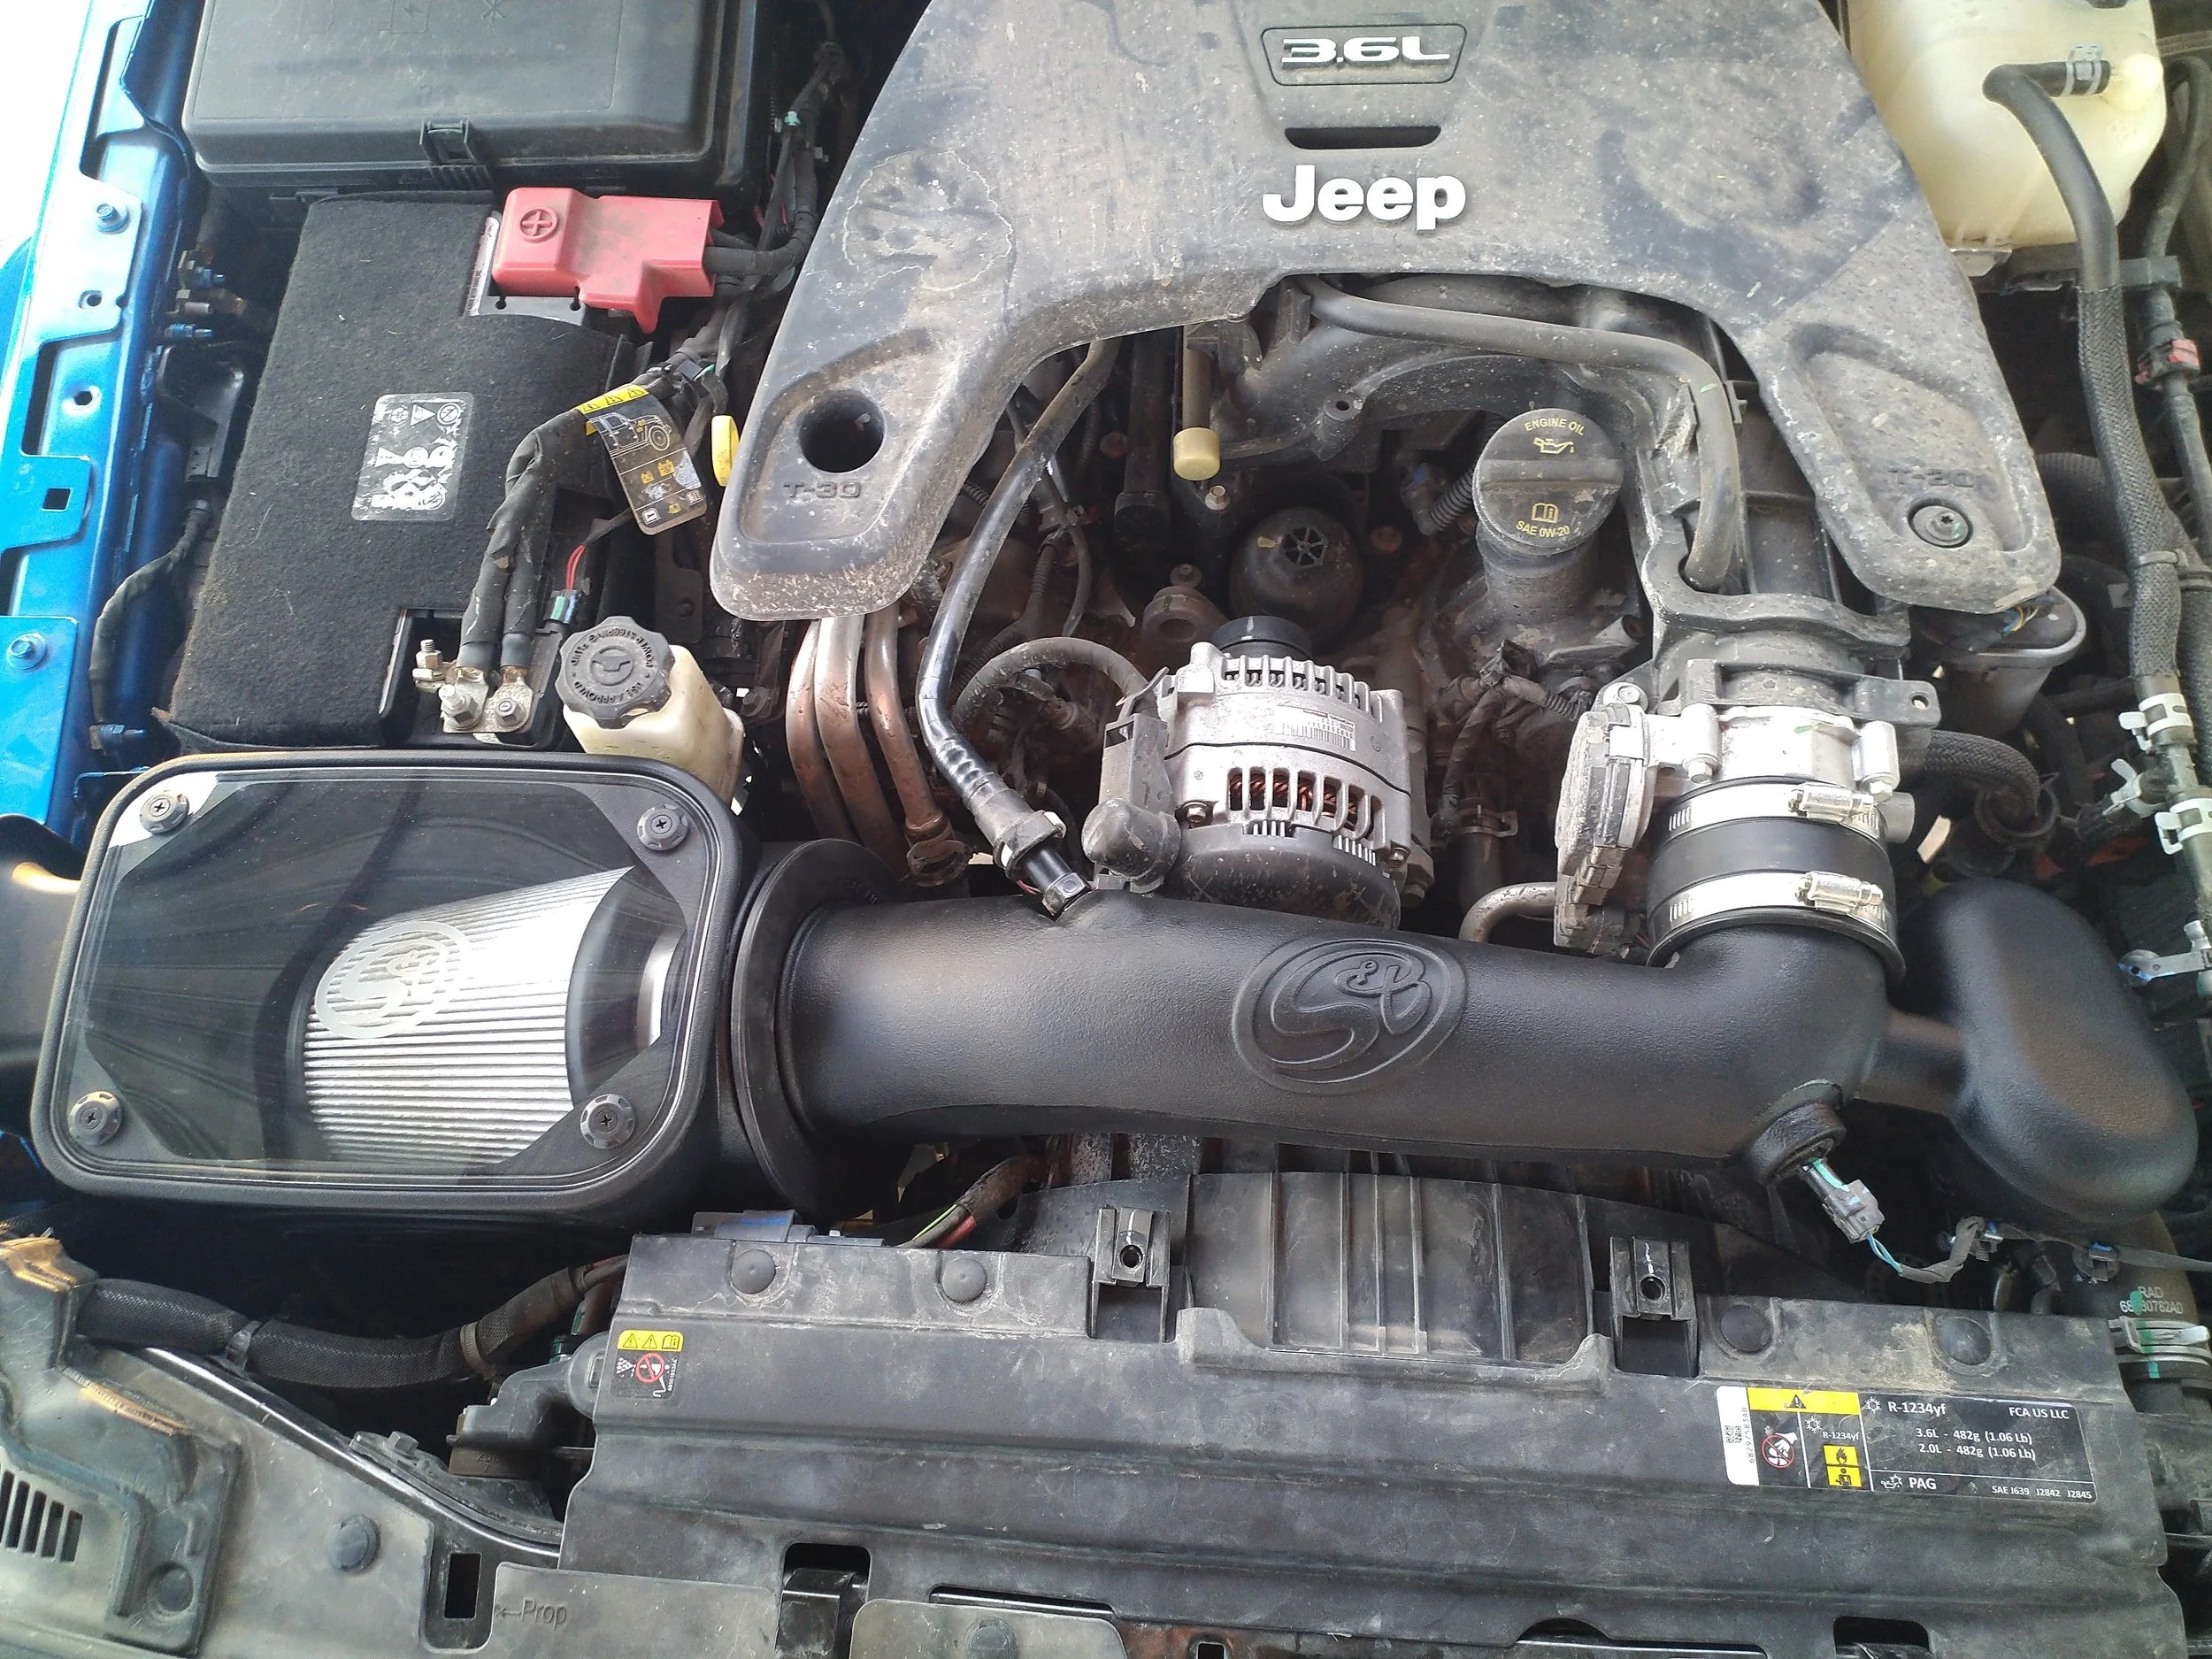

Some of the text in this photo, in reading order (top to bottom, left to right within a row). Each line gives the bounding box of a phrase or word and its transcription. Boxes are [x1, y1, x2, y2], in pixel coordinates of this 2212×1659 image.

[1282, 36, 1450, 63] 3.6L
[1262, 165, 1466, 231] Jeep
[1525, 418, 1586, 436] ENGINE OIL
[783, 481, 862, 499] T-30
[1516, 520, 1571, 538] SAE 0W-20
[2138, 1286, 2163, 1299] RAD
[1887, 1401, 1947, 1417] R-1234yf
[2008, 1407, 2070, 1419] FCA US LLC
[1823, 1431, 1860, 1442] R-1234yf
[1916, 1428, 1939, 1439] 3.6L
[1953, 1430, 1980, 1442] 482g
[1985, 1431, 2013, 1443] (1.06
[2015, 1432, 2032, 1446] Lb)
[1918, 1443, 1942, 1454] 2.0L
[1956, 1445, 1984, 1458] 482g
[1988, 1446, 2015, 1459] (1.06
[2017, 1448, 2037, 1462] Lb)
[1909, 1477, 1937, 1490] PAG
[1992, 1485, 2093, 1500] SAE J639 J2842 J2845
[521, 1598, 568, 1630] Prop
